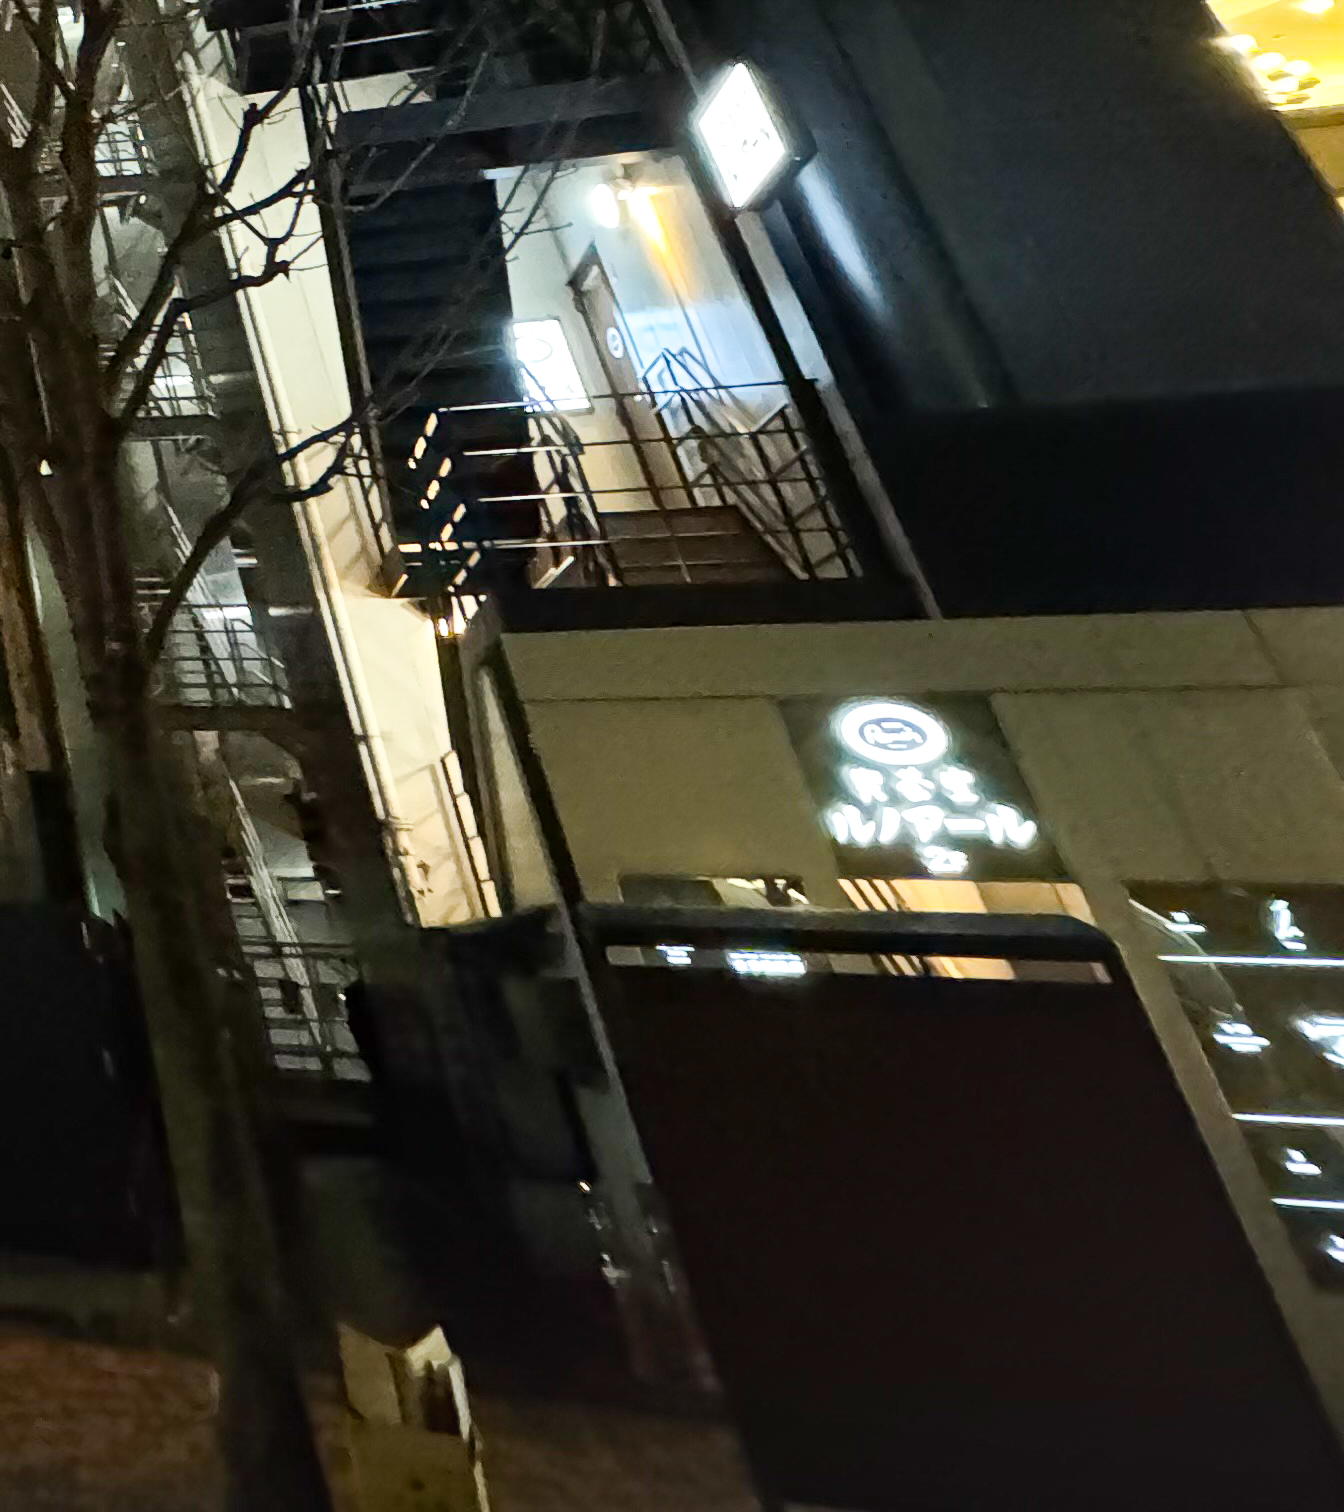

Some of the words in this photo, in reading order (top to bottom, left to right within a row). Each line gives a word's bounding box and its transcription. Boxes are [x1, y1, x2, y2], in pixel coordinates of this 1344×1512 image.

[828, 803, 1038, 849] ルノアール
